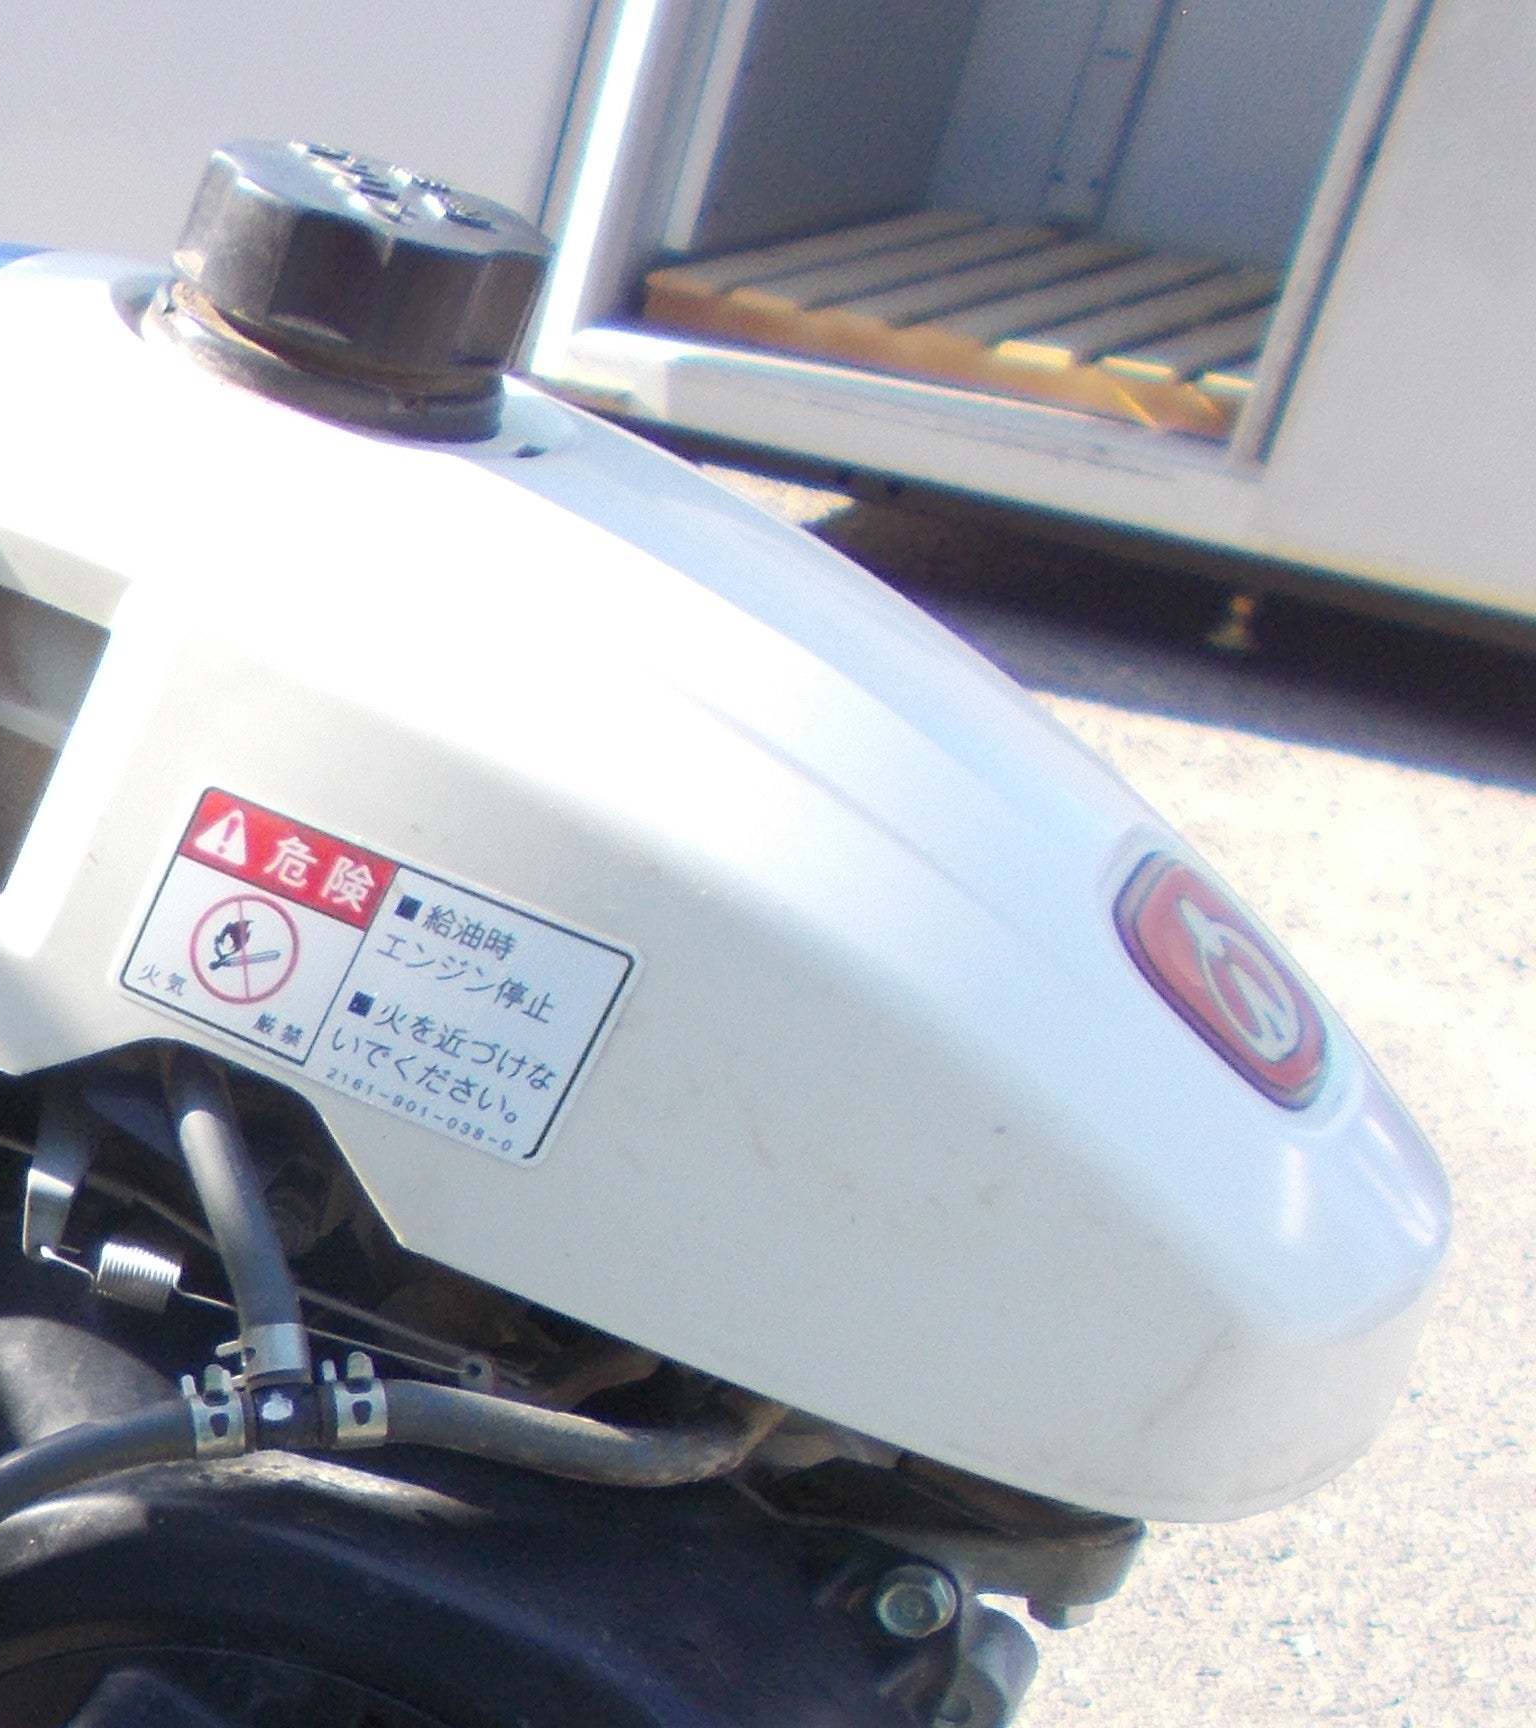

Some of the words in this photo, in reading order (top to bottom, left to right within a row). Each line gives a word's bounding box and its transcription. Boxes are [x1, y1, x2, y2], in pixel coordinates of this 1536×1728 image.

[262, 833, 378, 914] 危険
[421, 904, 518, 962] 給油時
[139, 962, 189, 998] 火気
[375, 931, 558, 1026] エンジン停止
[250, 1011, 306, 1047] 厳禁
[376, 1001, 558, 1092] 火を近づけな
[330, 1026, 520, 1126] いでください。
